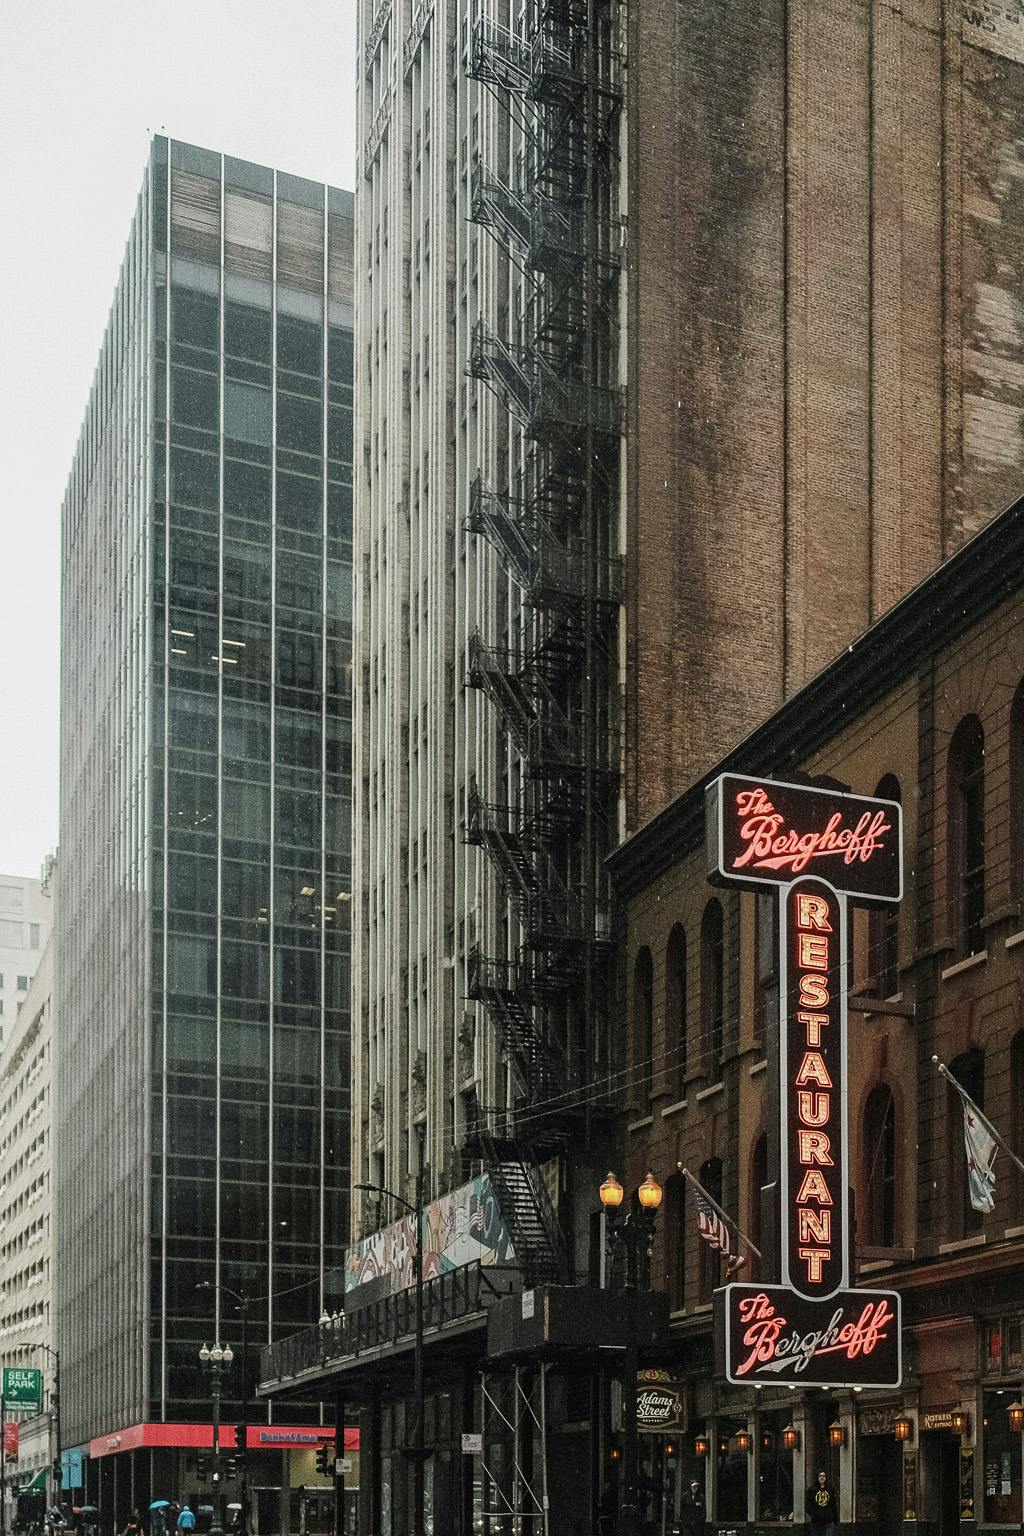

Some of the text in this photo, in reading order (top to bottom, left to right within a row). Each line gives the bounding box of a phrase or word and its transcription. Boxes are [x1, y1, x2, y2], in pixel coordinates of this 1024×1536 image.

[736, 788, 774, 816] The
[732, 811, 891, 872] Berghoff
[796, 894, 834, 1282] RESTAURANT
[738, 1293, 775, 1322] The
[735, 1300, 893, 1375] Berghoff
[8, 1371, 35, 1380] SELF
[8, 1380, 36, 1389] PARK
[636, 1392, 674, 1406] Adams
[636, 1403, 671, 1418] Street
